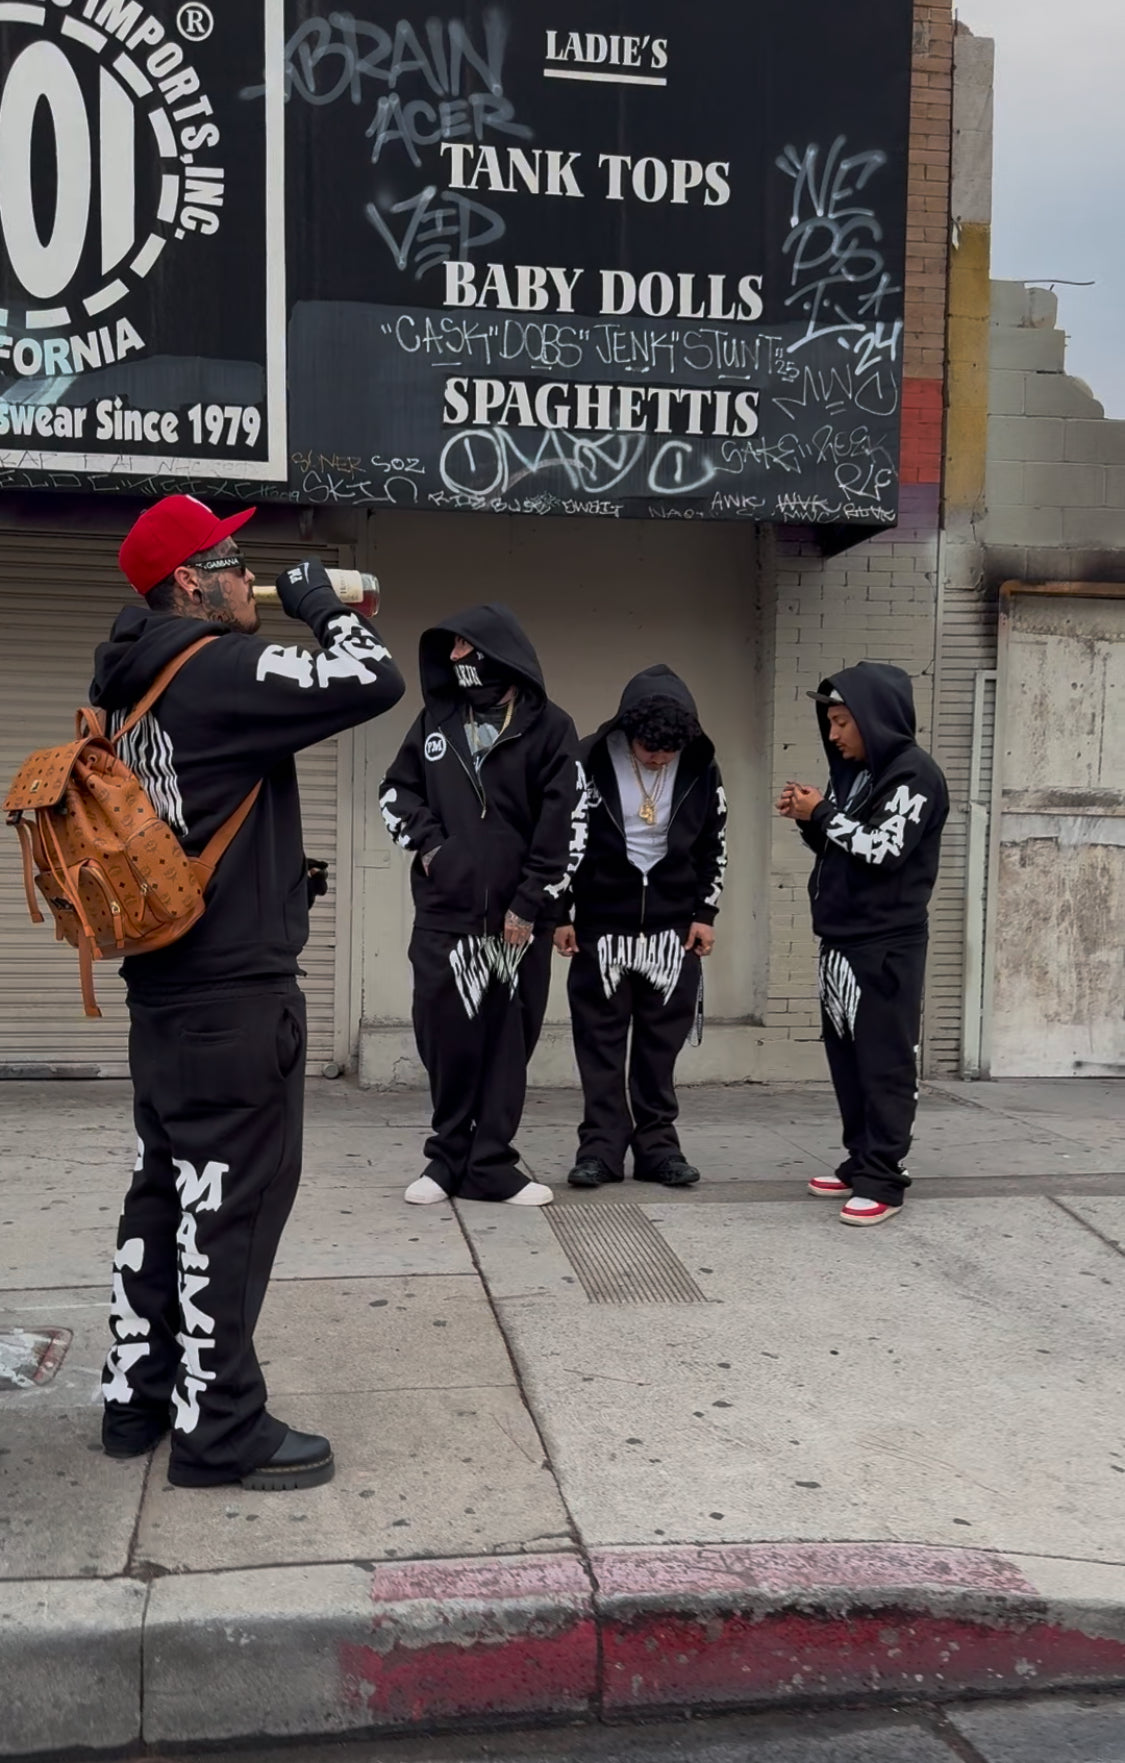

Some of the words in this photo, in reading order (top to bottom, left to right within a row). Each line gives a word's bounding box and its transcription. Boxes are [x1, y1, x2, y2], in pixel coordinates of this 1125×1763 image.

[545, 30, 668, 68] LADIE'S
[440, 142, 584, 197] TANK
[598, 153, 731, 206] TOPS
[443, 260, 584, 312] BABY
[599, 269, 763, 320] DOLLS
[96, 396, 179, 443] Since
[187, 402, 261, 447] 1979
[443, 377, 760, 437] SPAGHETTIS
